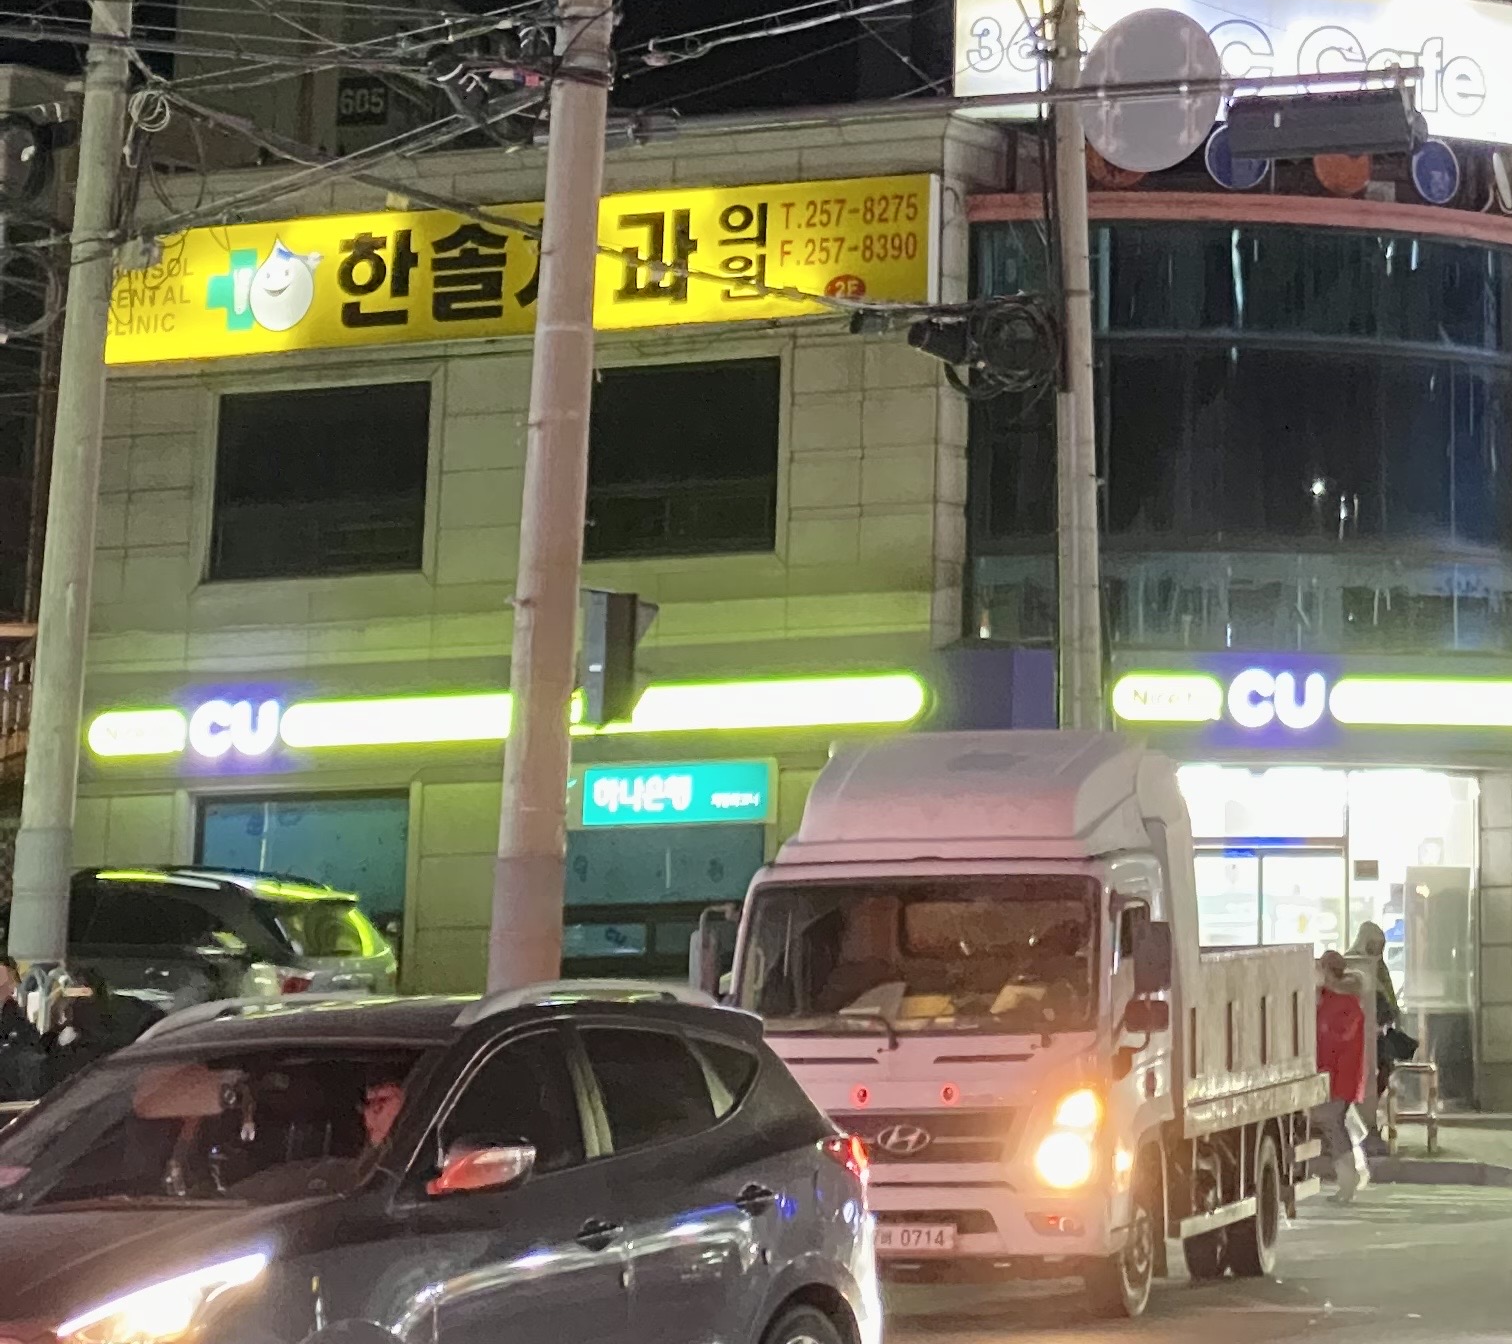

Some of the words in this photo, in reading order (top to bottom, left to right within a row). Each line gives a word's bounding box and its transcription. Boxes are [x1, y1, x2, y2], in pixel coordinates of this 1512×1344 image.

[780, 192, 919, 230] T.257-8275
[779, 232, 918, 268] F.257-8390
[115, 285, 192, 309] ENTAL
[1227, 668, 1326, 730] CU
[188, 698, 280, 758] CU
[900, 1229, 945, 1247] 0714
